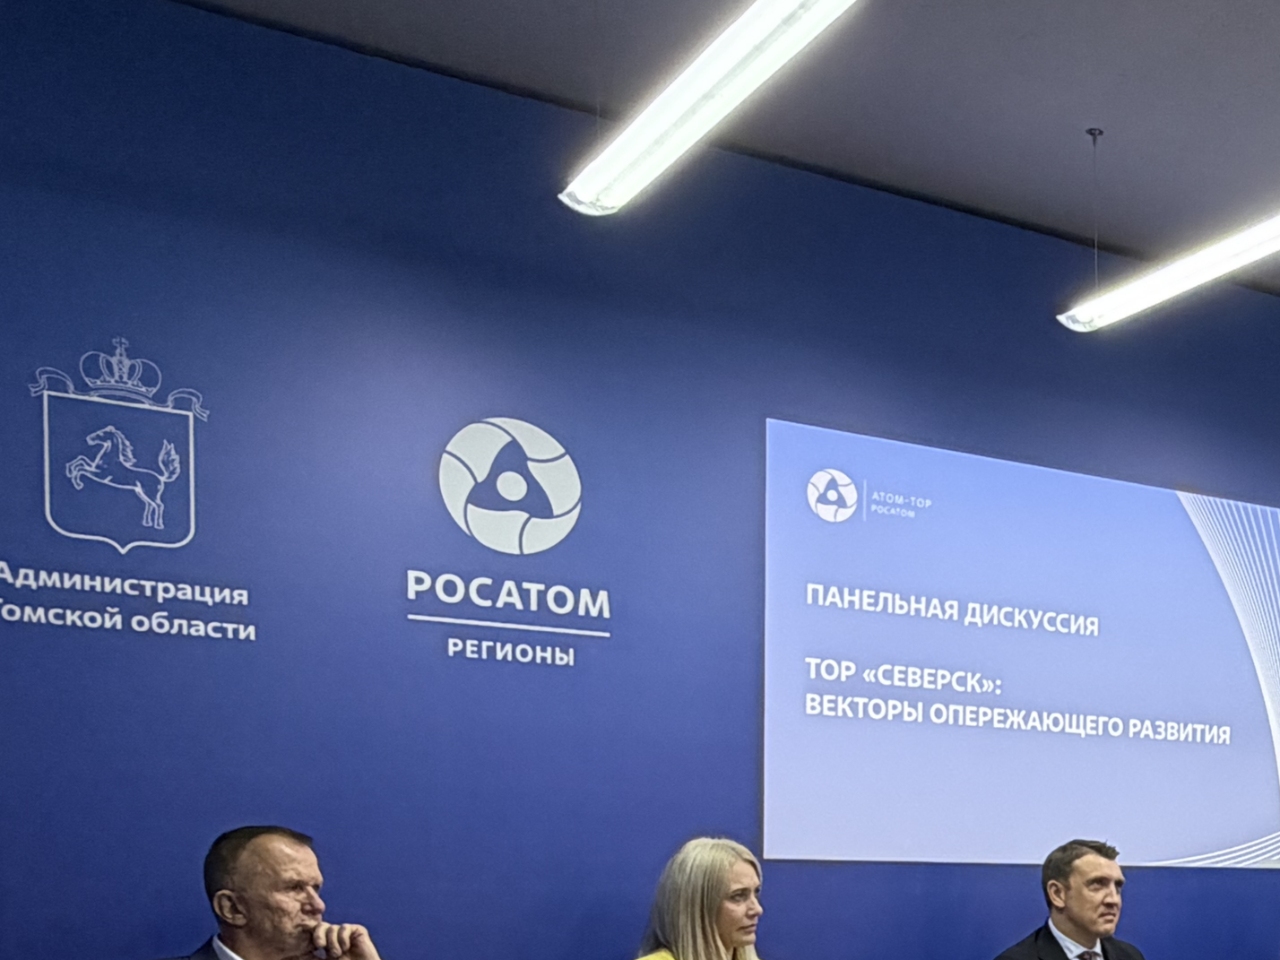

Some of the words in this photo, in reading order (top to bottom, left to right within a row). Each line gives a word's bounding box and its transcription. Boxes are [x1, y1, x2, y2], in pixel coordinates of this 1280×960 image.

[870, 505, 915, 518] РОСАТОМ
[871, 491, 932, 509] АТОМ-ТОР
[0, 561, 249, 606] Администрация
[406, 569, 611, 619] РОСАТОМ
[0, 598, 123, 630] омской
[131, 611, 256, 640] области
[806, 583, 959, 621] ПАНЕЛЬНАЯ
[963, 602, 1100, 637] ДИСКУССИЯ
[448, 637, 575, 666] РЕГИОНЫ
[805, 657, 857, 682] ТОР
[862, 664, 1002, 695] «СЕВЕРСК»:
[805, 693, 923, 723] ВЕКТОРЫ
[929, 702, 1124, 738] ОПЕРЕЖАЮЩЕГО
[1128, 719, 1231, 745] РАЗВИТИЯ
